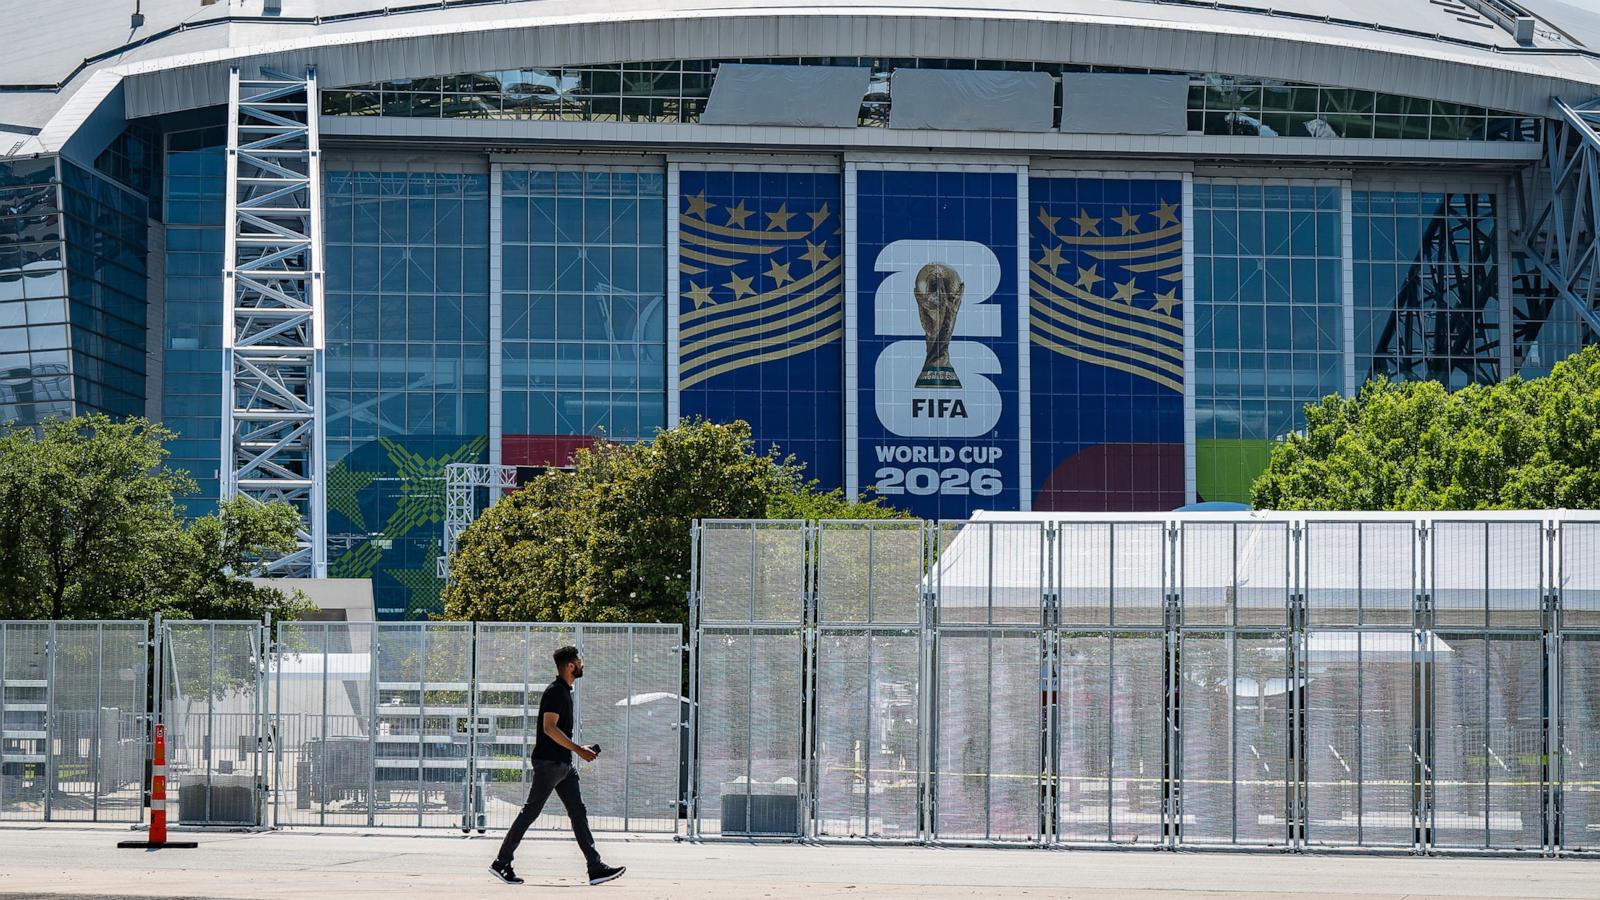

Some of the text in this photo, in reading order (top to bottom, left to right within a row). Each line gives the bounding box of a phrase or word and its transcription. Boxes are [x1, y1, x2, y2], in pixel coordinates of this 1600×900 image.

[911, 398, 968, 418] FIFA
[875, 445, 1003, 464] WORLD CUP
[875, 467, 1003, 496] 2026
